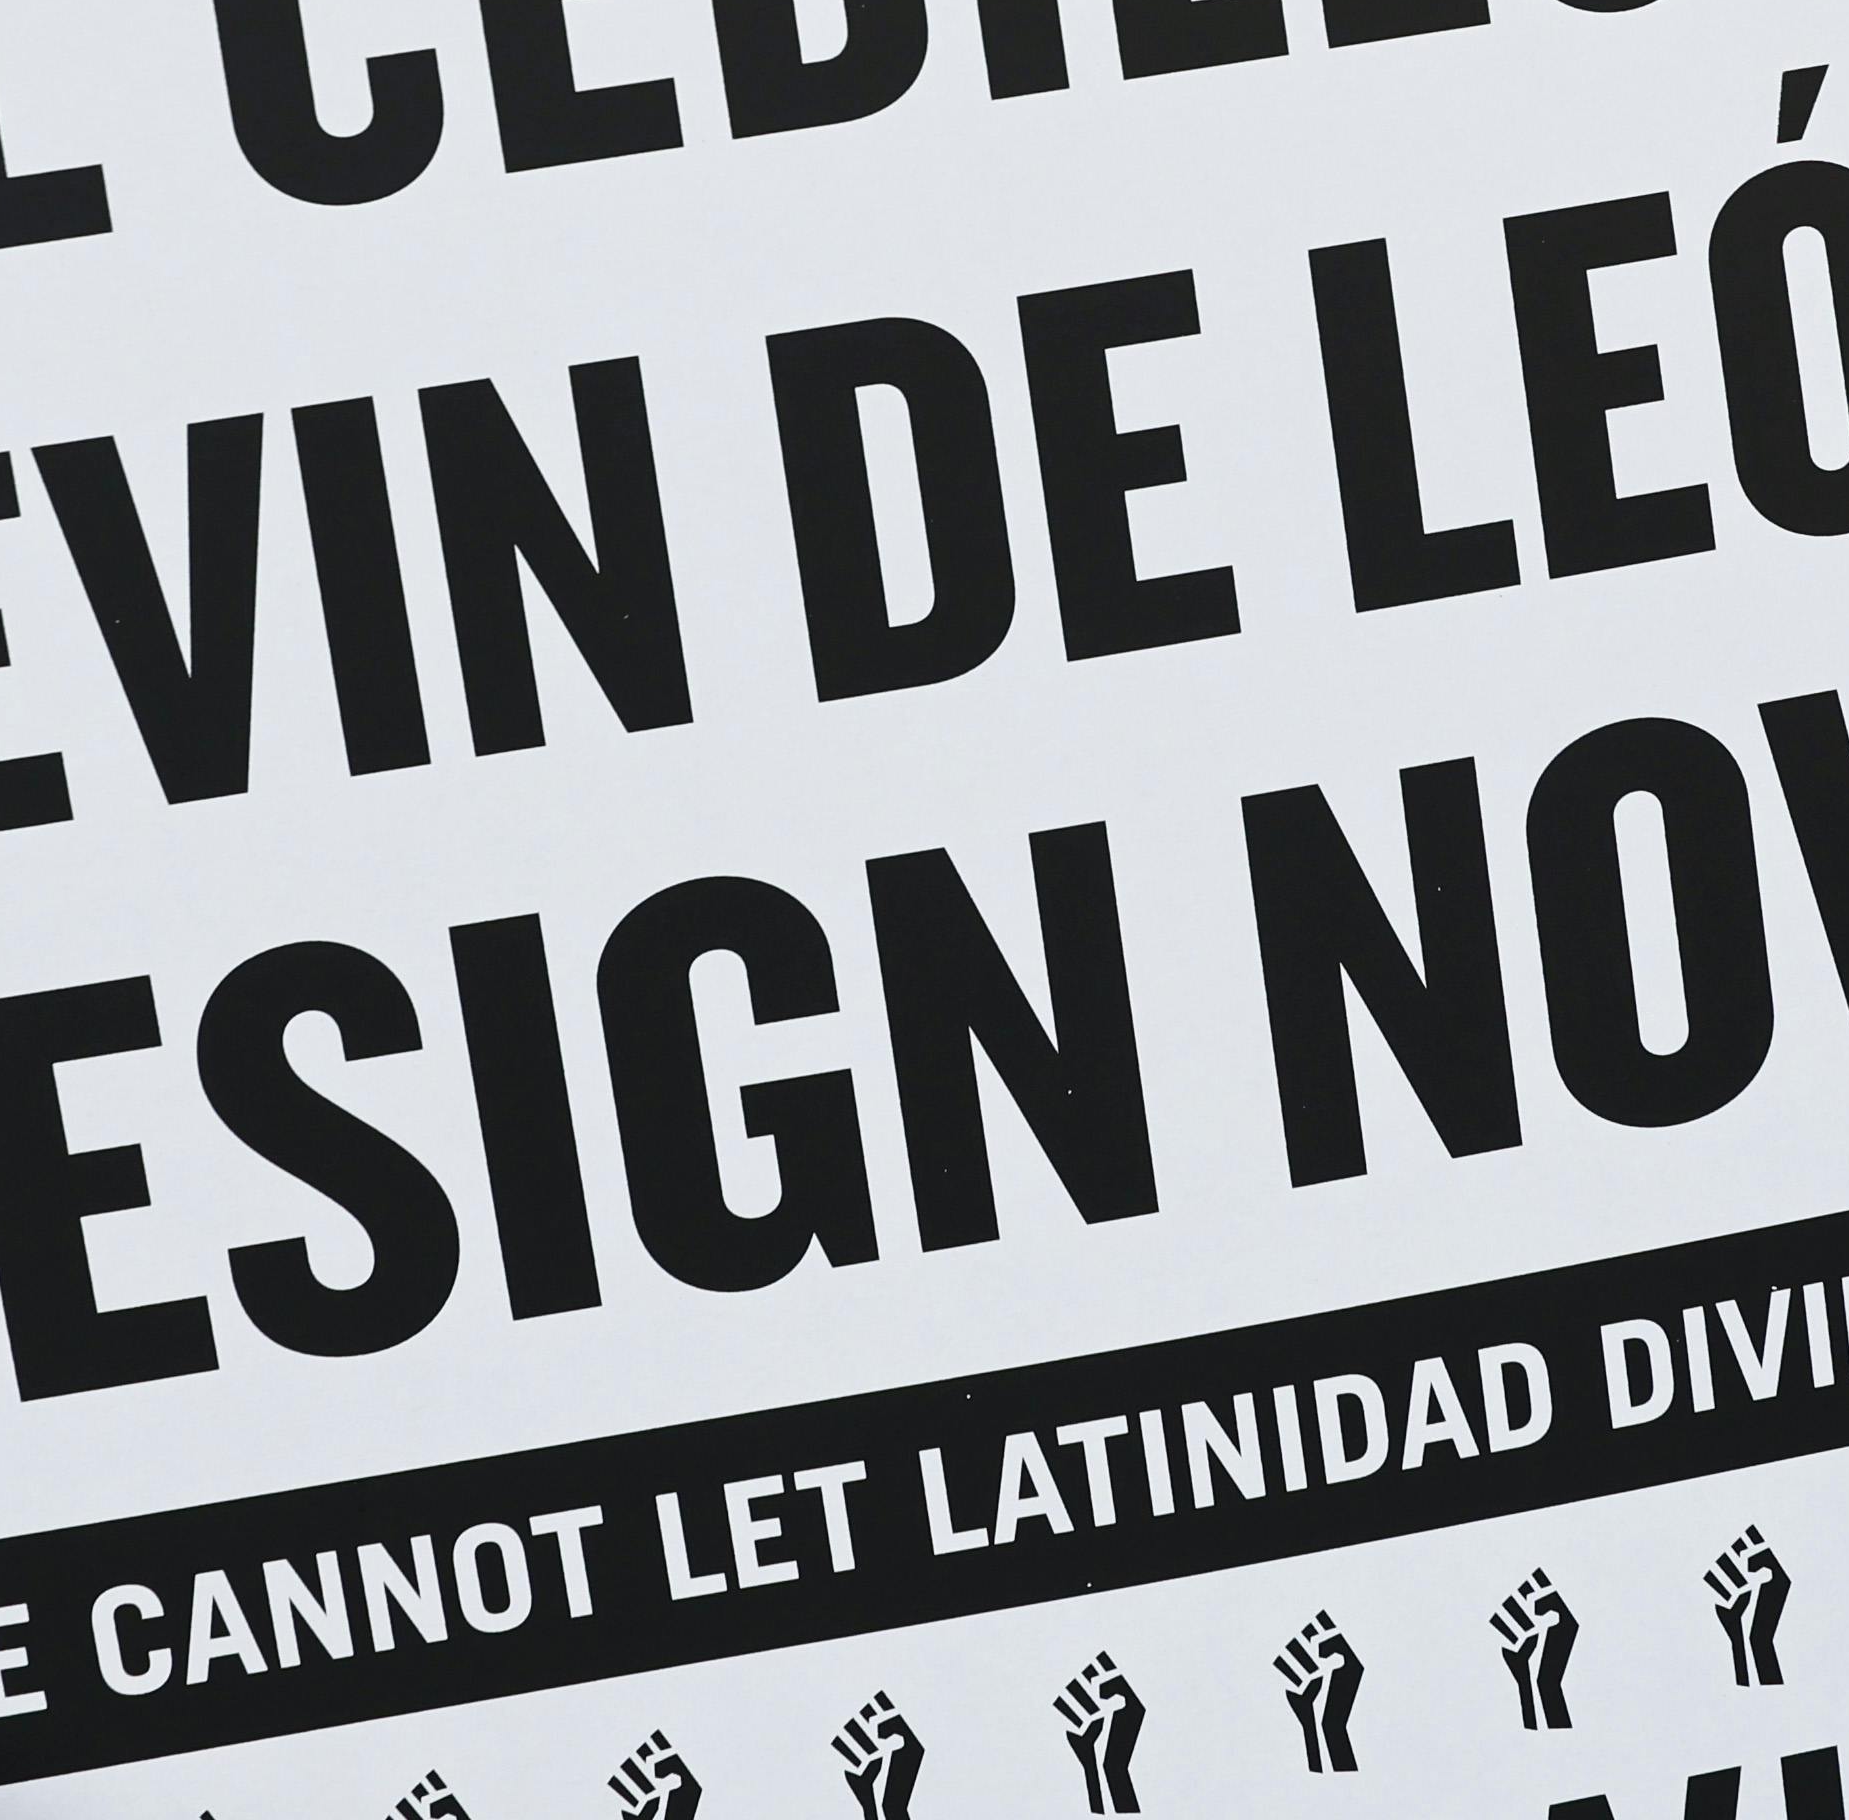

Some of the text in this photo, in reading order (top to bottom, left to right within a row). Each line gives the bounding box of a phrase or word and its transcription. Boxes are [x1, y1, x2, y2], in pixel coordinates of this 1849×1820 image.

[766, 269, 1241, 702] DE
[92, 1505, 603, 1695] CANNOT
[656, 1461, 866, 1600] LET
[919, 1343, 1552, 1555] LATINIDAD
